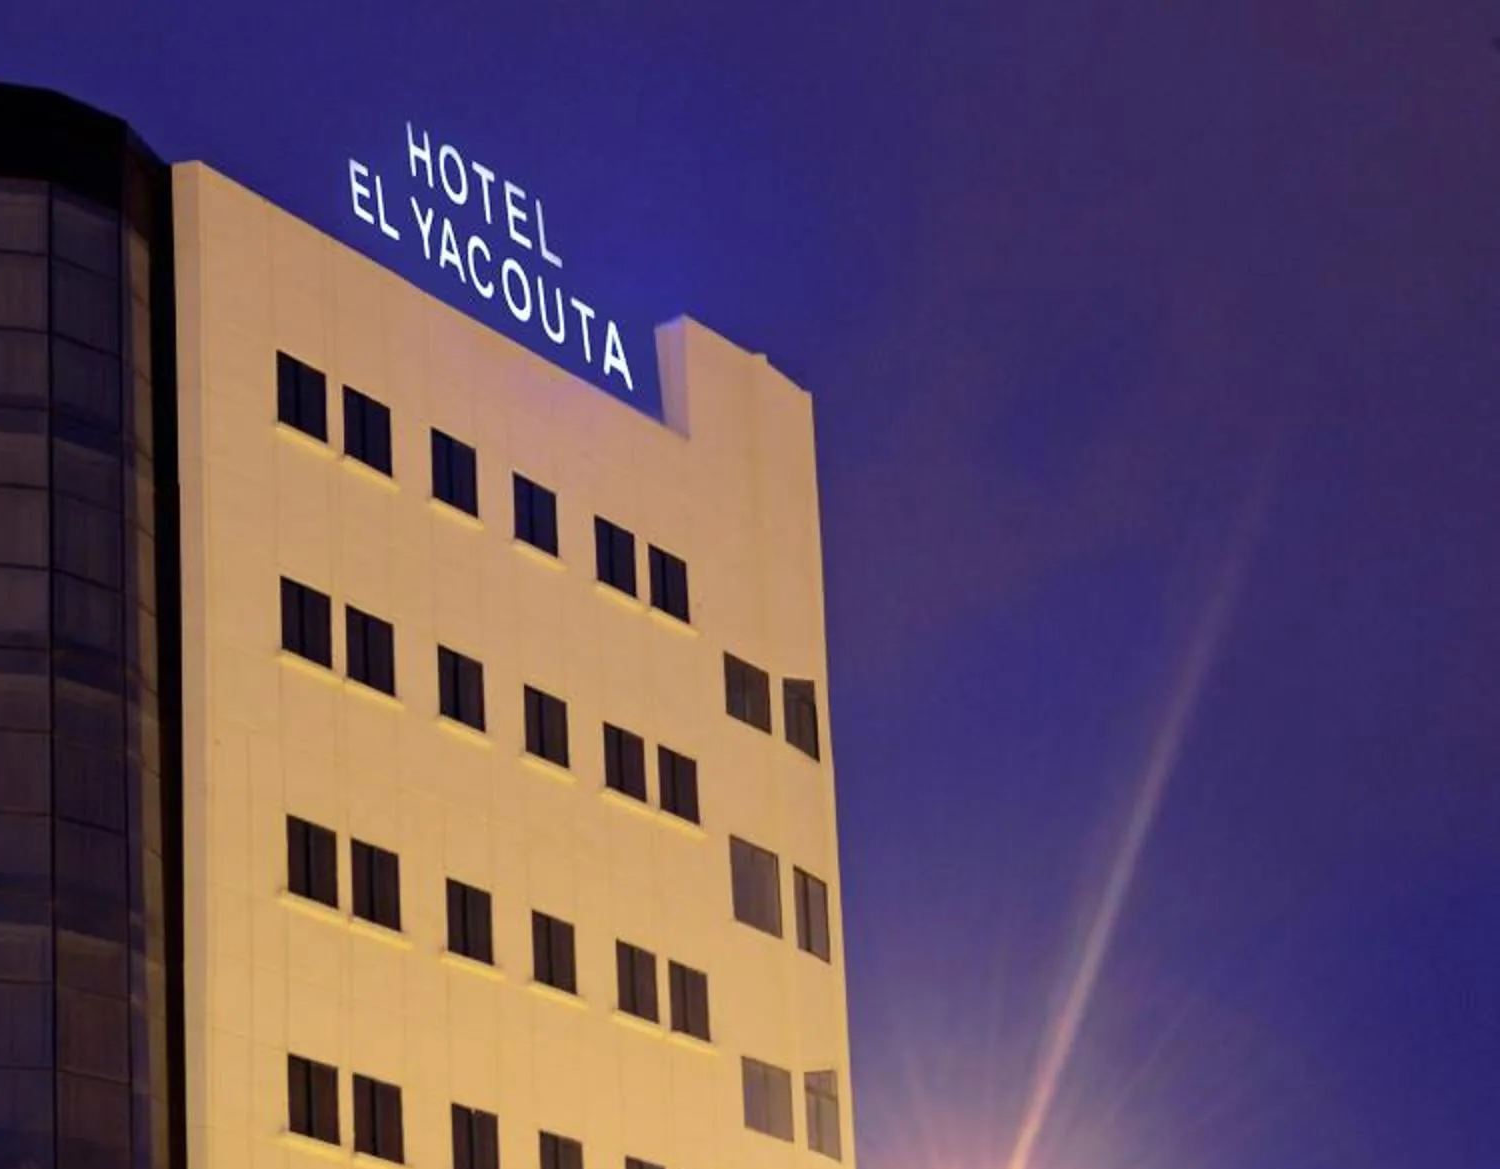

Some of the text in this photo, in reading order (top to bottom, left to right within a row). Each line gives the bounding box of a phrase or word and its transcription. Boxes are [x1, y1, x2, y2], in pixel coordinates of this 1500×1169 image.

[349, 158, 634, 391] EL YACOUTA
[406, 121, 563, 269] HOTEL
